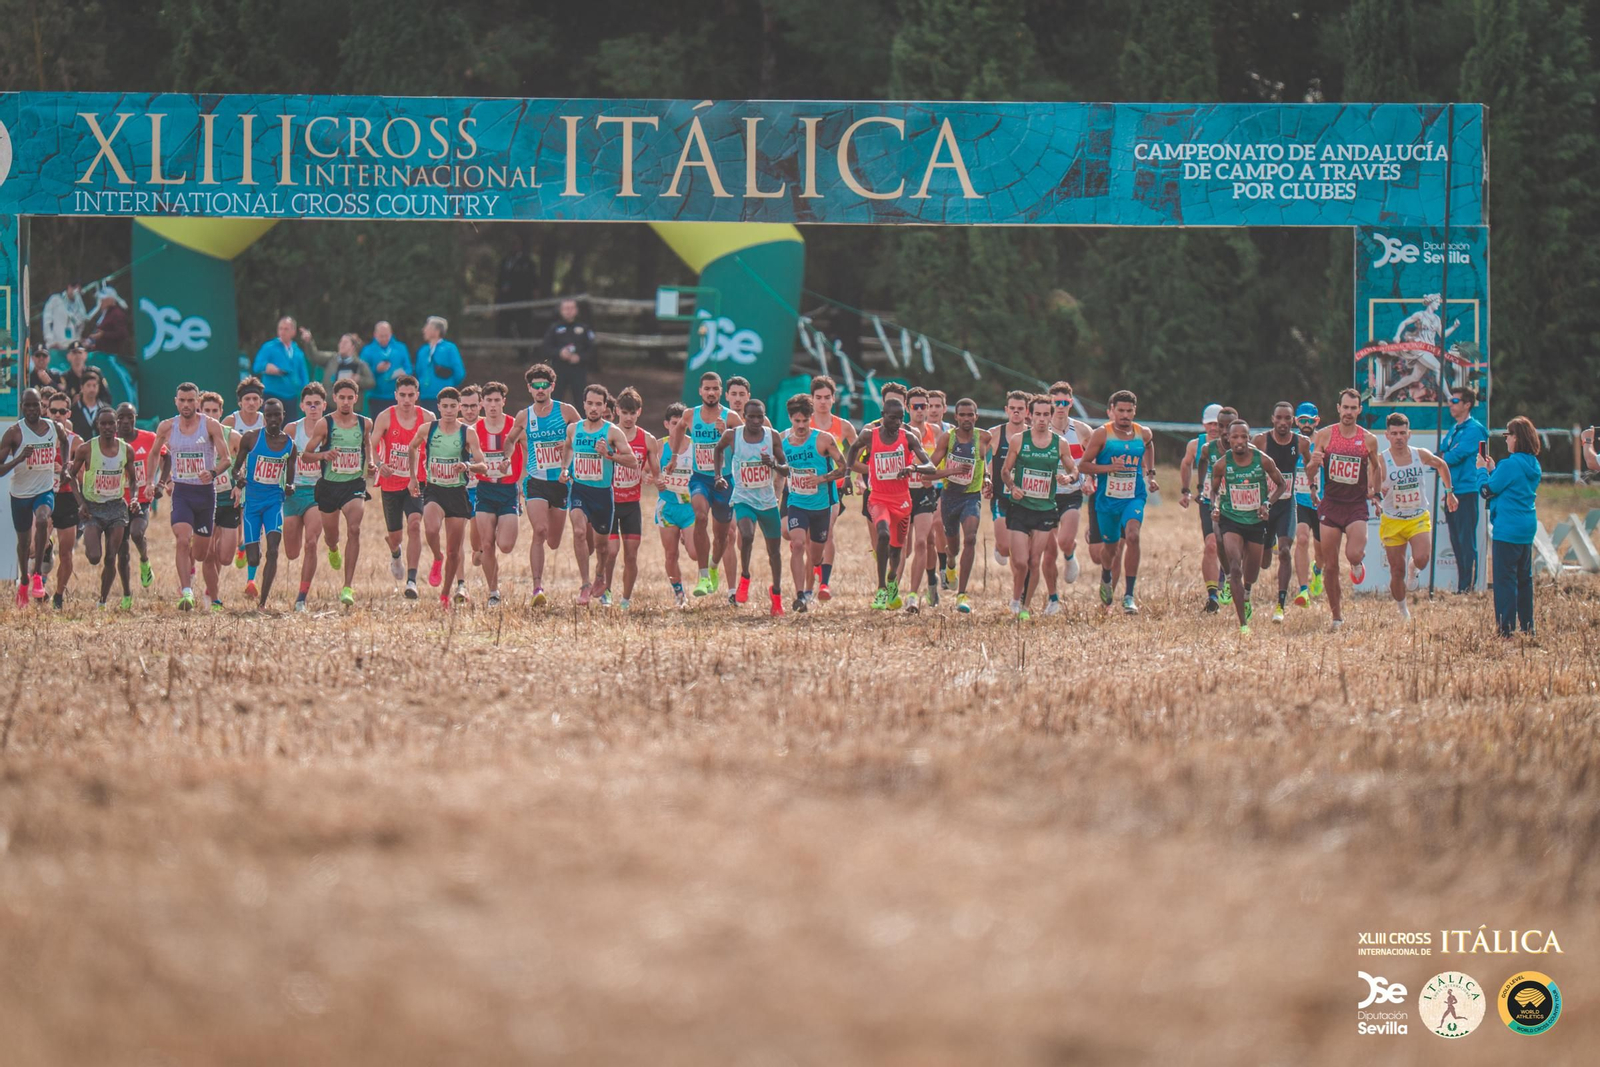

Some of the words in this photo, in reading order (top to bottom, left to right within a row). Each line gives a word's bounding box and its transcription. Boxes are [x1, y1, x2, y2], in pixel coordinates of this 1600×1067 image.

[304, 117, 478, 159] CROSS
[75, 113, 299, 186] XLIII
[559, 100, 984, 199] ITÁLICA
[1134, 144, 1284, 161] CAMPEONATO
[1288, 145, 1316, 161] DE
[1320, 141, 1450, 162] ANDALUCÍA
[304, 164, 542, 189] INTERNACIONAL
[1184, 163, 1212, 180] DE
[1215, 164, 1294, 181] CAMPO
[1297, 164, 1316, 181] A
[1319, 160, 1401, 181] TRAVÉS
[1233, 182, 1277, 200] POR
[1279, 182, 1356, 200] CLUBES
[75, 191, 285, 213] INTERNATIONAL
[291, 193, 370, 215] CROSS
[376, 194, 500, 216] COUNTRY
[1423, 242, 1470, 250] Diputción
[528, 429, 556, 439] TOLOSA
[576, 437, 597, 449] nerj
[787, 450, 814, 462] nerja
[254, 461, 284, 478] KIBET
[741, 466, 771, 483] KOECH
[1329, 459, 1360, 479] ARCE
[1389, 468, 1423, 481] CORIA
[664, 475, 689, 487] 5122
[1109, 480, 1133, 492] 5118
[1395, 491, 1420, 503] 5112
